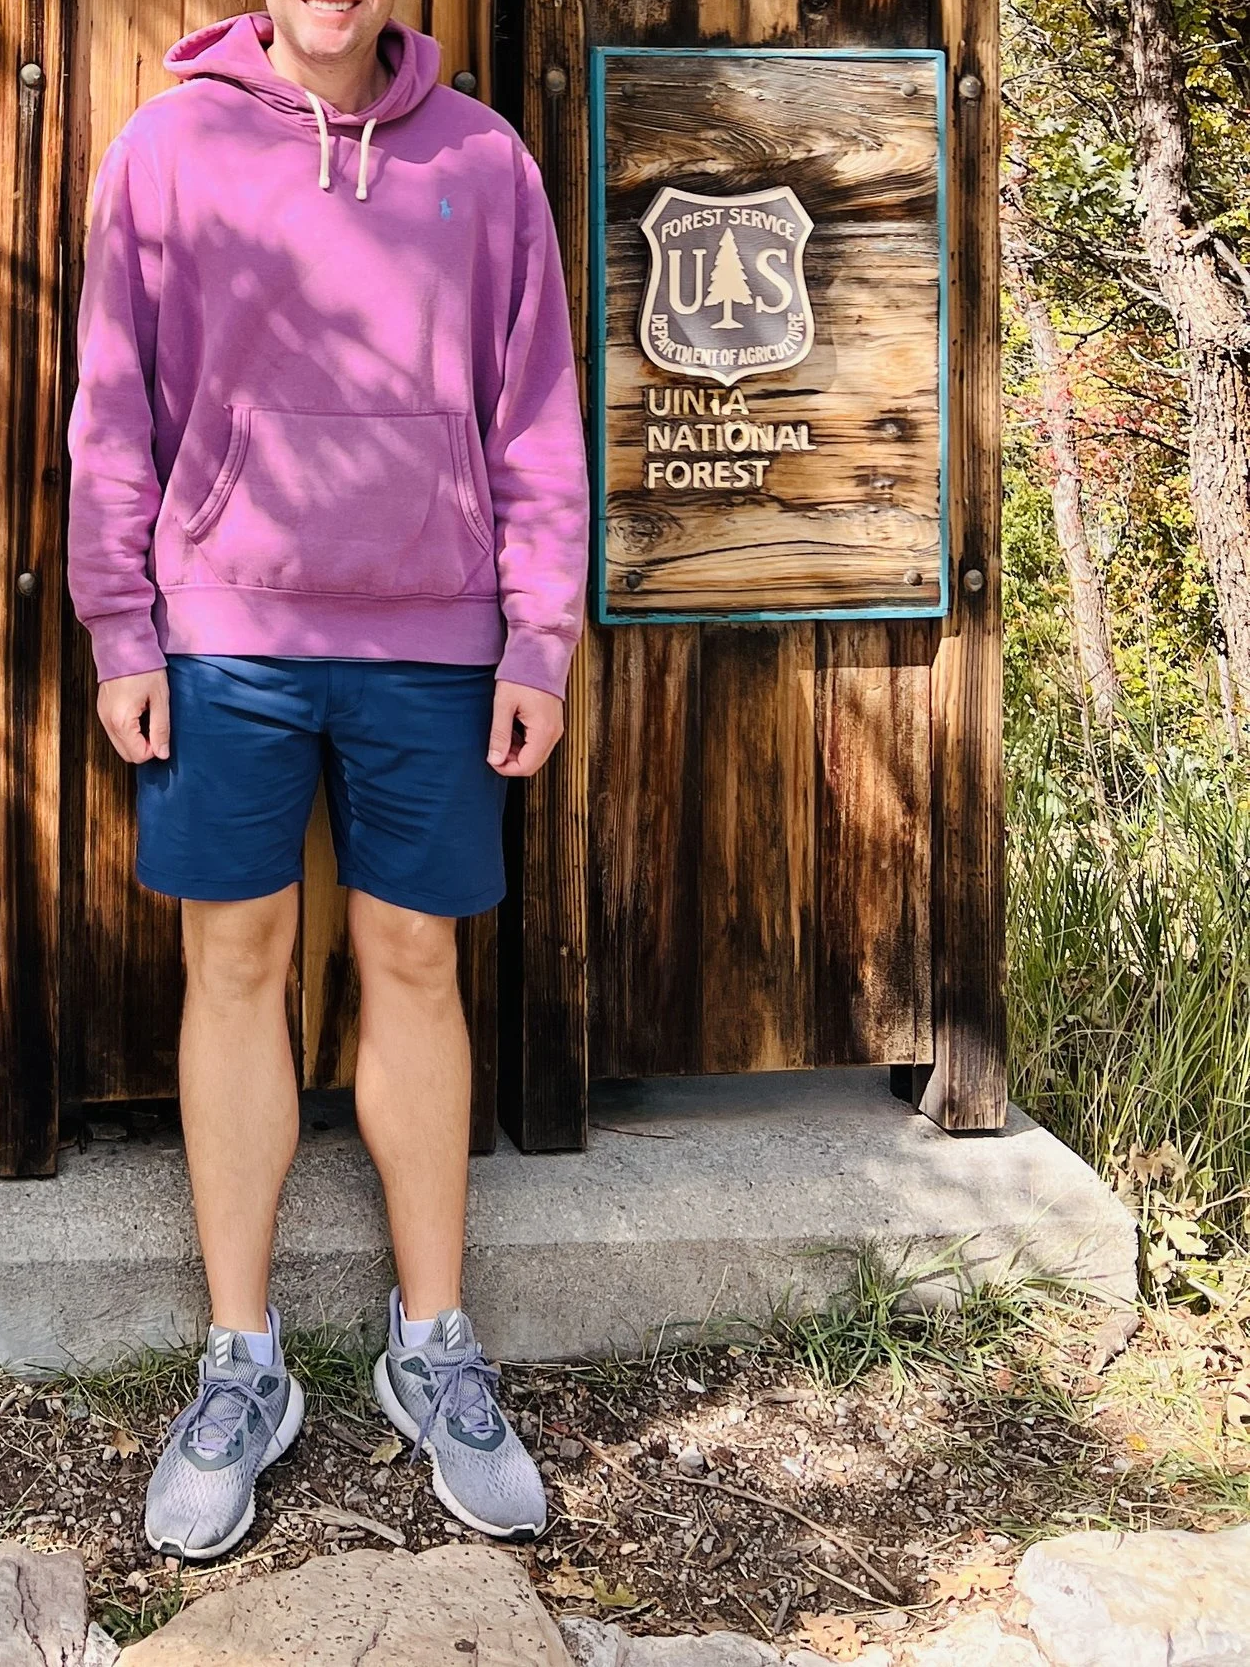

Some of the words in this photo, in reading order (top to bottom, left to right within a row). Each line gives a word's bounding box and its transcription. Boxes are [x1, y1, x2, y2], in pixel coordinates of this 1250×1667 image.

[661, 208, 725, 243] FOREST
[728, 207, 796, 242] SERVICE
[668, 248, 707, 315] U
[755, 248, 793, 314] S
[651, 314, 720, 366] DEPARTMENT
[720, 348, 738, 366] OF
[737, 312, 805, 366] AGRICULTURE
[648, 388, 750, 416] UINTA
[647, 420, 818, 452] NATIONAL
[647, 460, 771, 489] FOREST
